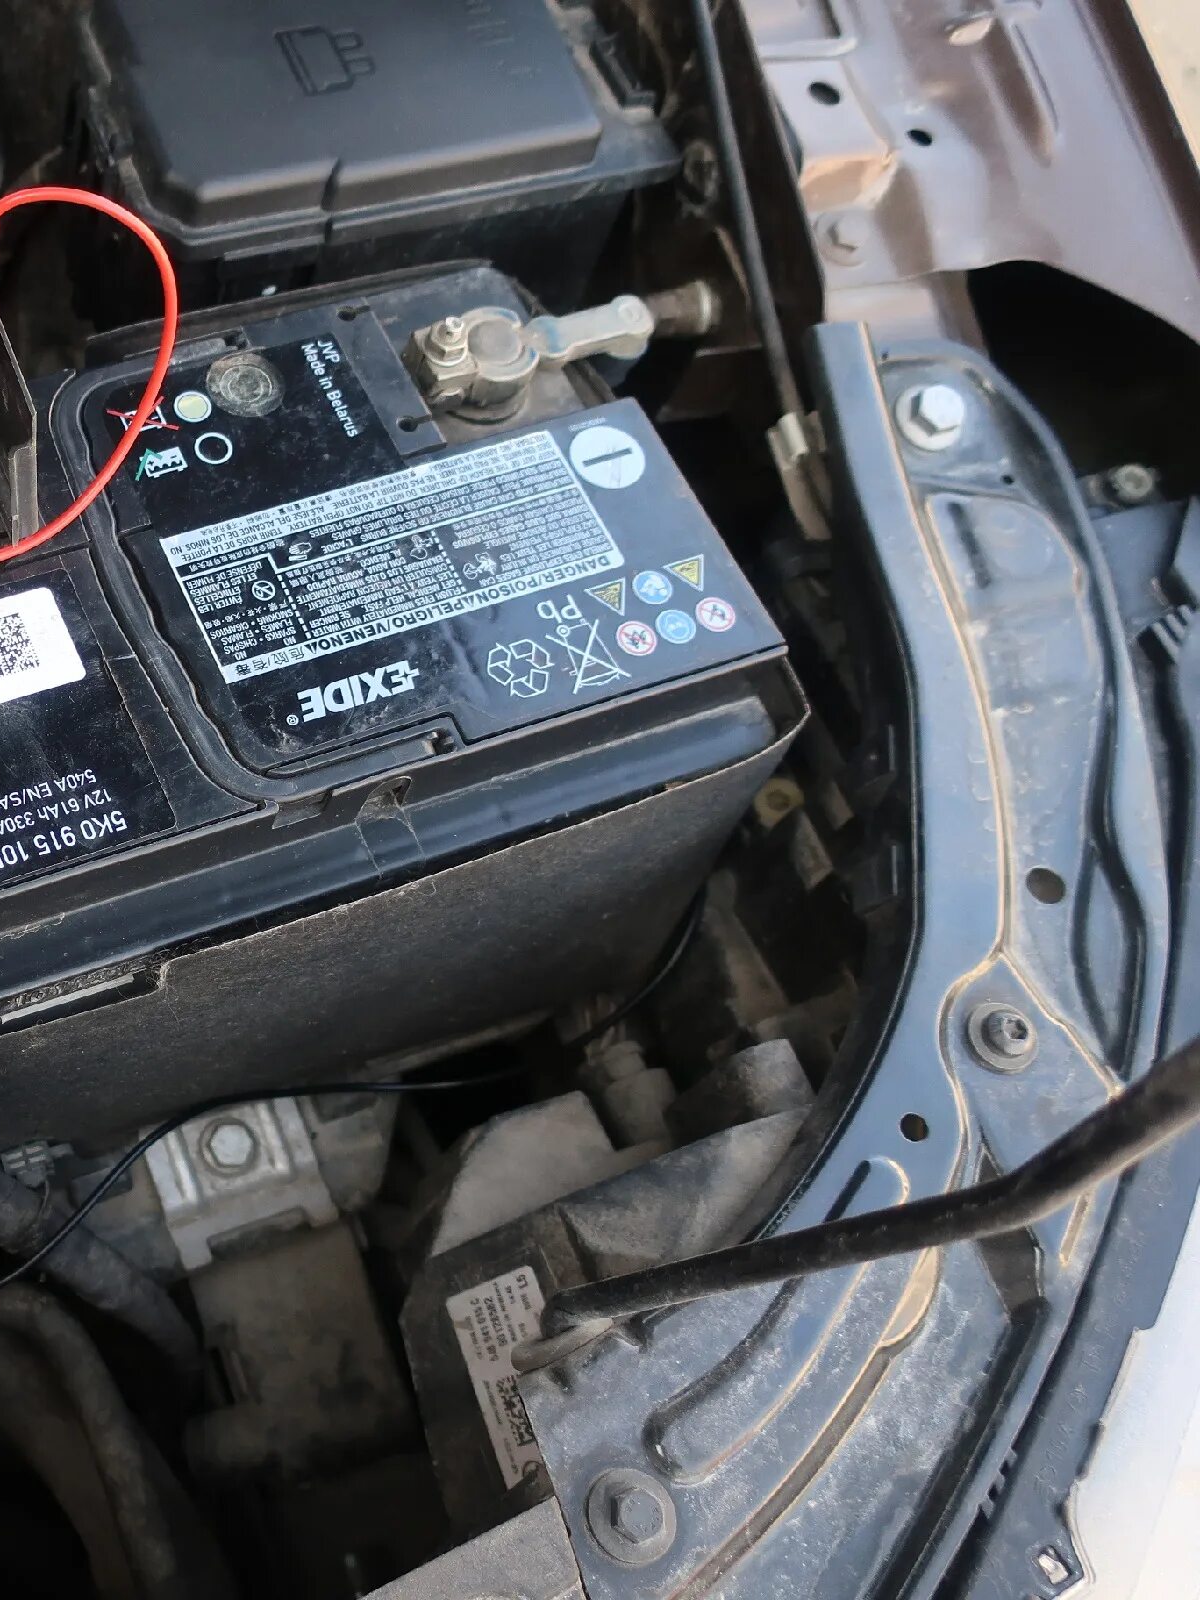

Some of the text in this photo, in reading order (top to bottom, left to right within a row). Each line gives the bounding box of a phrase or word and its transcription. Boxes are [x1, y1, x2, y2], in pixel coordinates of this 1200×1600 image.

[318, 340, 340, 362] JVP
[302, 343, 358, 437] Made in Belarus
[322, 509, 344, 521] OPEN
[344, 504, 361, 515] NOT
[169, 519, 275, 555] ALCANCE DE LOS NO
[211, 527, 282, 552] TENIR HORS DE LA
[308, 522, 343, 538] FUERTES
[329, 525, 363, 541] GRAVES
[358, 519, 417, 542] SEVERE BURNS
[389, 548, 402, 558] AL
[402, 554, 444, 572] ENJUAGUE
[335, 556, 406, 583] CON ACUDA
[364, 571, 387, 584] OJOS
[386, 566, 403, 577] LOS
[390, 562, 448, 586] CONSULTER UN
[434, 570, 452, 581] LES
[185, 571, 227, 590] DE FUMER
[189, 571, 258, 597] ET LES FLAMMES
[404, 583, 440, 599] MEDICAL
[414, 575, 436, 587] YEUX
[439, 578, 456, 589] GET
[196, 602, 215, 615] LES
[383, 593, 405, 606] HELP
[536, 594, 583, 623] Pb
[307, 609, 351, 628] SE RINCER
[311, 586, 461, 636] FLUSH EYES IMMEDIATELY WITH WATER
[208, 608, 293, 639] SMOKING CIGARROS
[220, 617, 293, 645] FLAMES FLAMAS
[222, 625, 296, 654] SPARKS CHISPAS
[282, 635, 296, 646] NO
[297, 660, 420, 722] EXIDE
[54, 769, 97, 792] 540A
[36, 798, 80, 820] 61Ah
[84, 788, 112, 809] 12V
[80, 810, 128, 840] 5K0
[34, 826, 76, 856] 915
